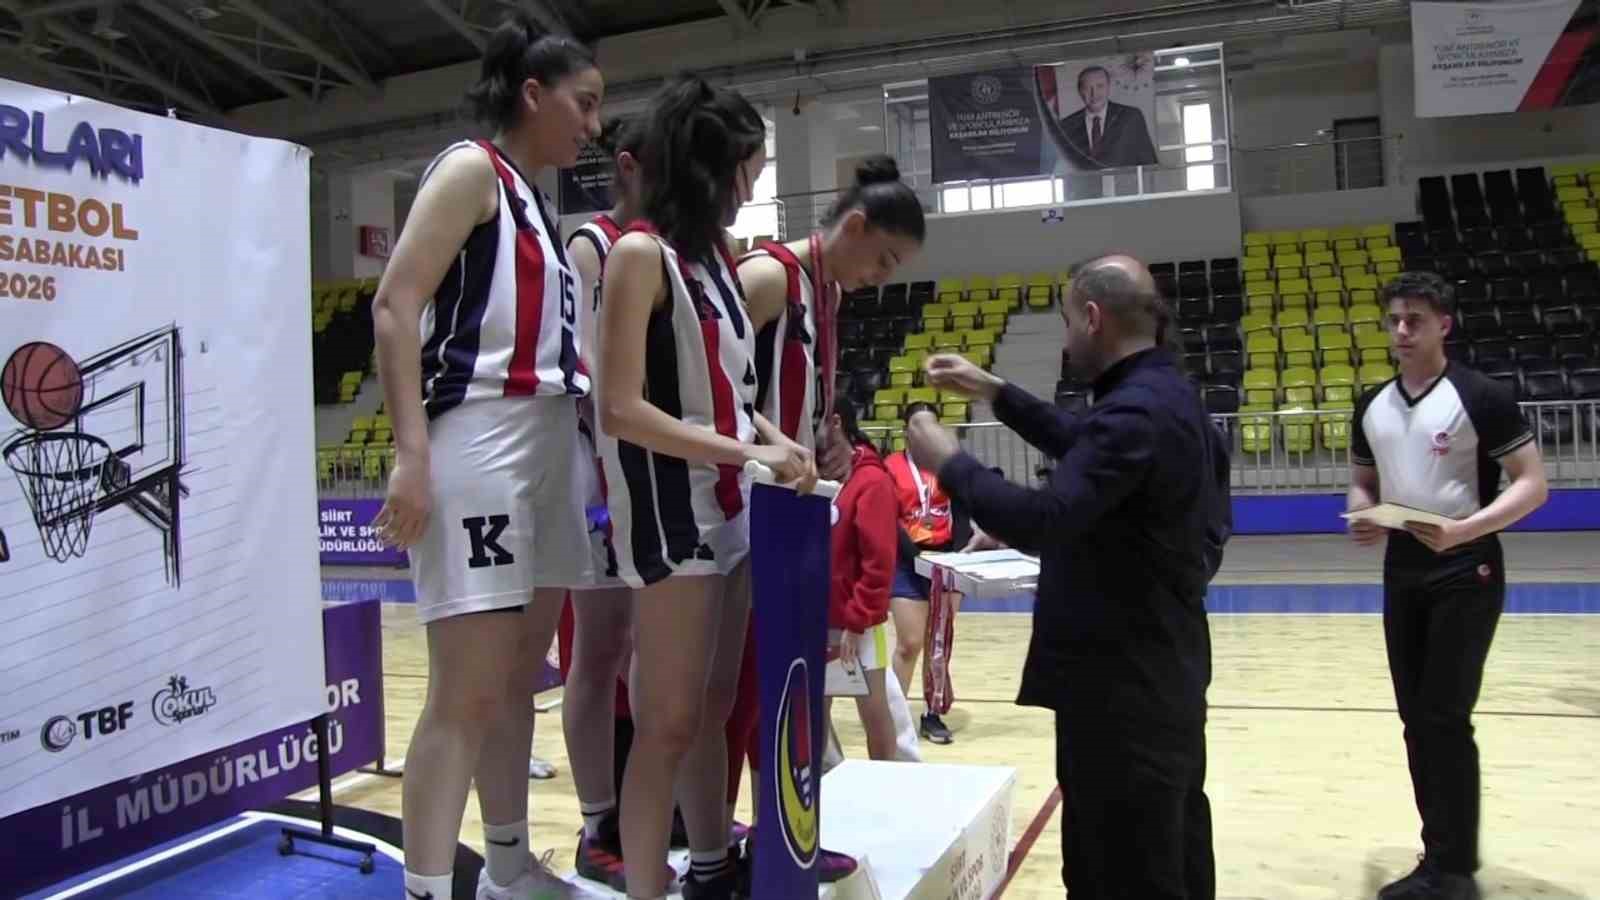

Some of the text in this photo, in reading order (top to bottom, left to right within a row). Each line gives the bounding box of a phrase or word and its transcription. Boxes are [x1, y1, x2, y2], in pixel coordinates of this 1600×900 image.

[0, 272, 57, 302] 2026
[340, 526, 356, 537] VE
[462, 514, 515, 568] K
[77, 700, 134, 740] TBF
[61, 804, 104, 849] İL
